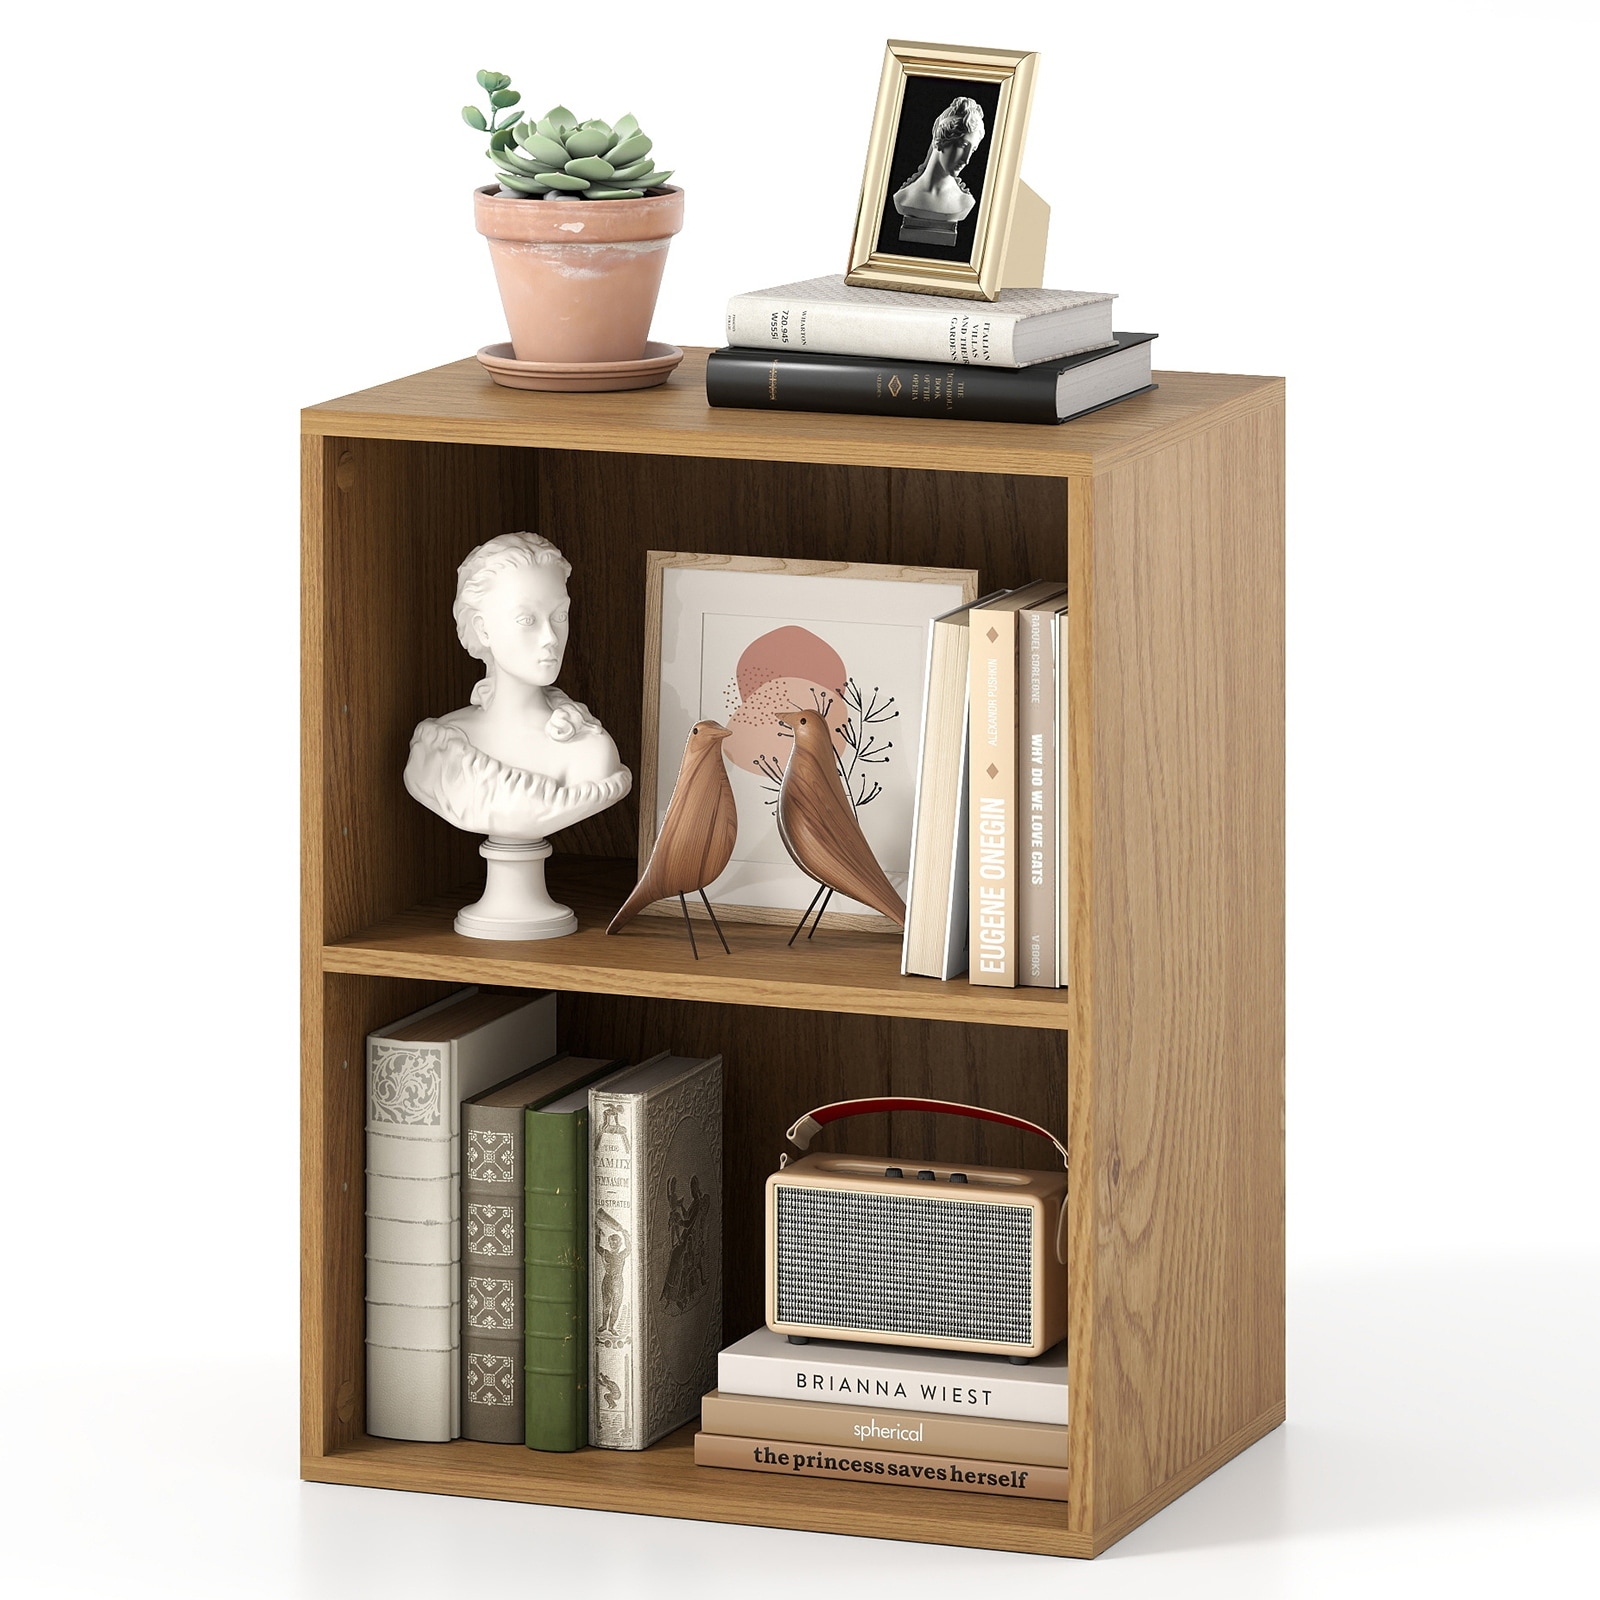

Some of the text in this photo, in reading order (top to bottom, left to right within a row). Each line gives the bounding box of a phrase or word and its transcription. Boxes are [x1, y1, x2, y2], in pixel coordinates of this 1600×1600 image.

[780, 309, 790, 344] 720.945
[800, 310, 808, 346] WHARTON
[949, 317, 958, 361] GARDENS
[960, 314, 970, 365] AND THEIR
[971, 324, 979, 358] VILLAS
[982, 322, 991, 361] ITALIAN
[911, 373, 919, 401] OPERA
[923, 373, 931, 402] OF THE
[934, 377, 942, 400] BOOK
[957, 380, 965, 399] THE
[1030, 614, 1041, 704] RAQUEL CORLEONE
[987, 658, 998, 747] ALEXANDR PUSHKIN
[1031, 733, 1043, 885] WHY DO WE LOVE CATS
[979, 797, 1006, 974] EUGENE ONEGIN
[1031, 944, 1041, 977] BOOKS
[603, 1144, 620, 1152] THE
[796, 1373, 992, 1406] BRIANNA WIEST
[853, 1418, 923, 1442] spherical
[753, 1446, 1029, 1489] the princess saves herself
